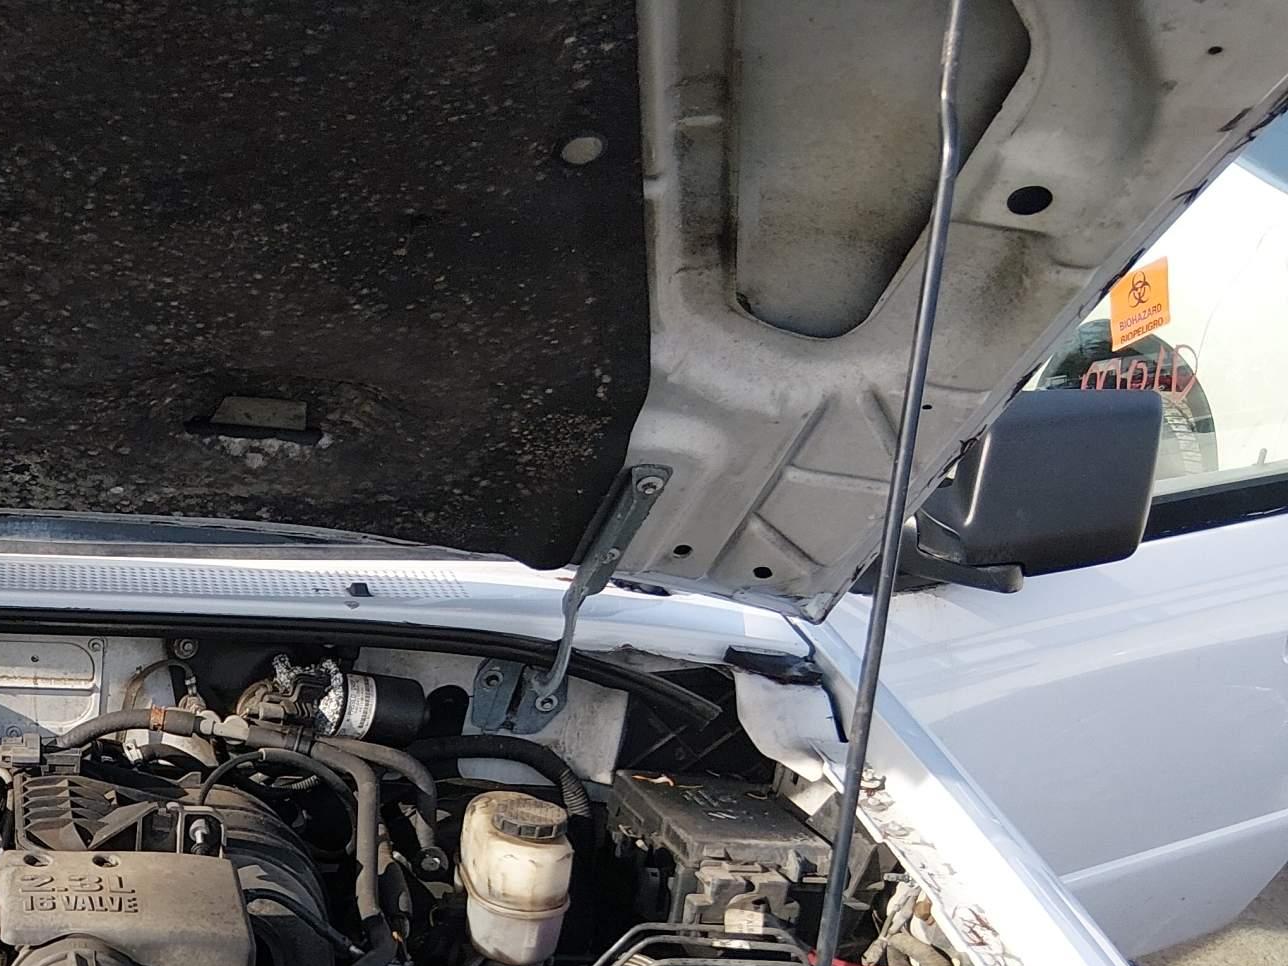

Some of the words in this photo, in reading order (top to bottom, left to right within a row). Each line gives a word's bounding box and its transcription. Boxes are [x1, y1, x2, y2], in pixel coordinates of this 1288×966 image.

[1119, 303, 1162, 331] BIOHAZARD
[1120, 316, 1164, 344] BIOPELIGRO
[20, 873, 136, 894] 2.3L
[22, 895, 57, 912] 16
[59, 895, 139, 913] VALVE
